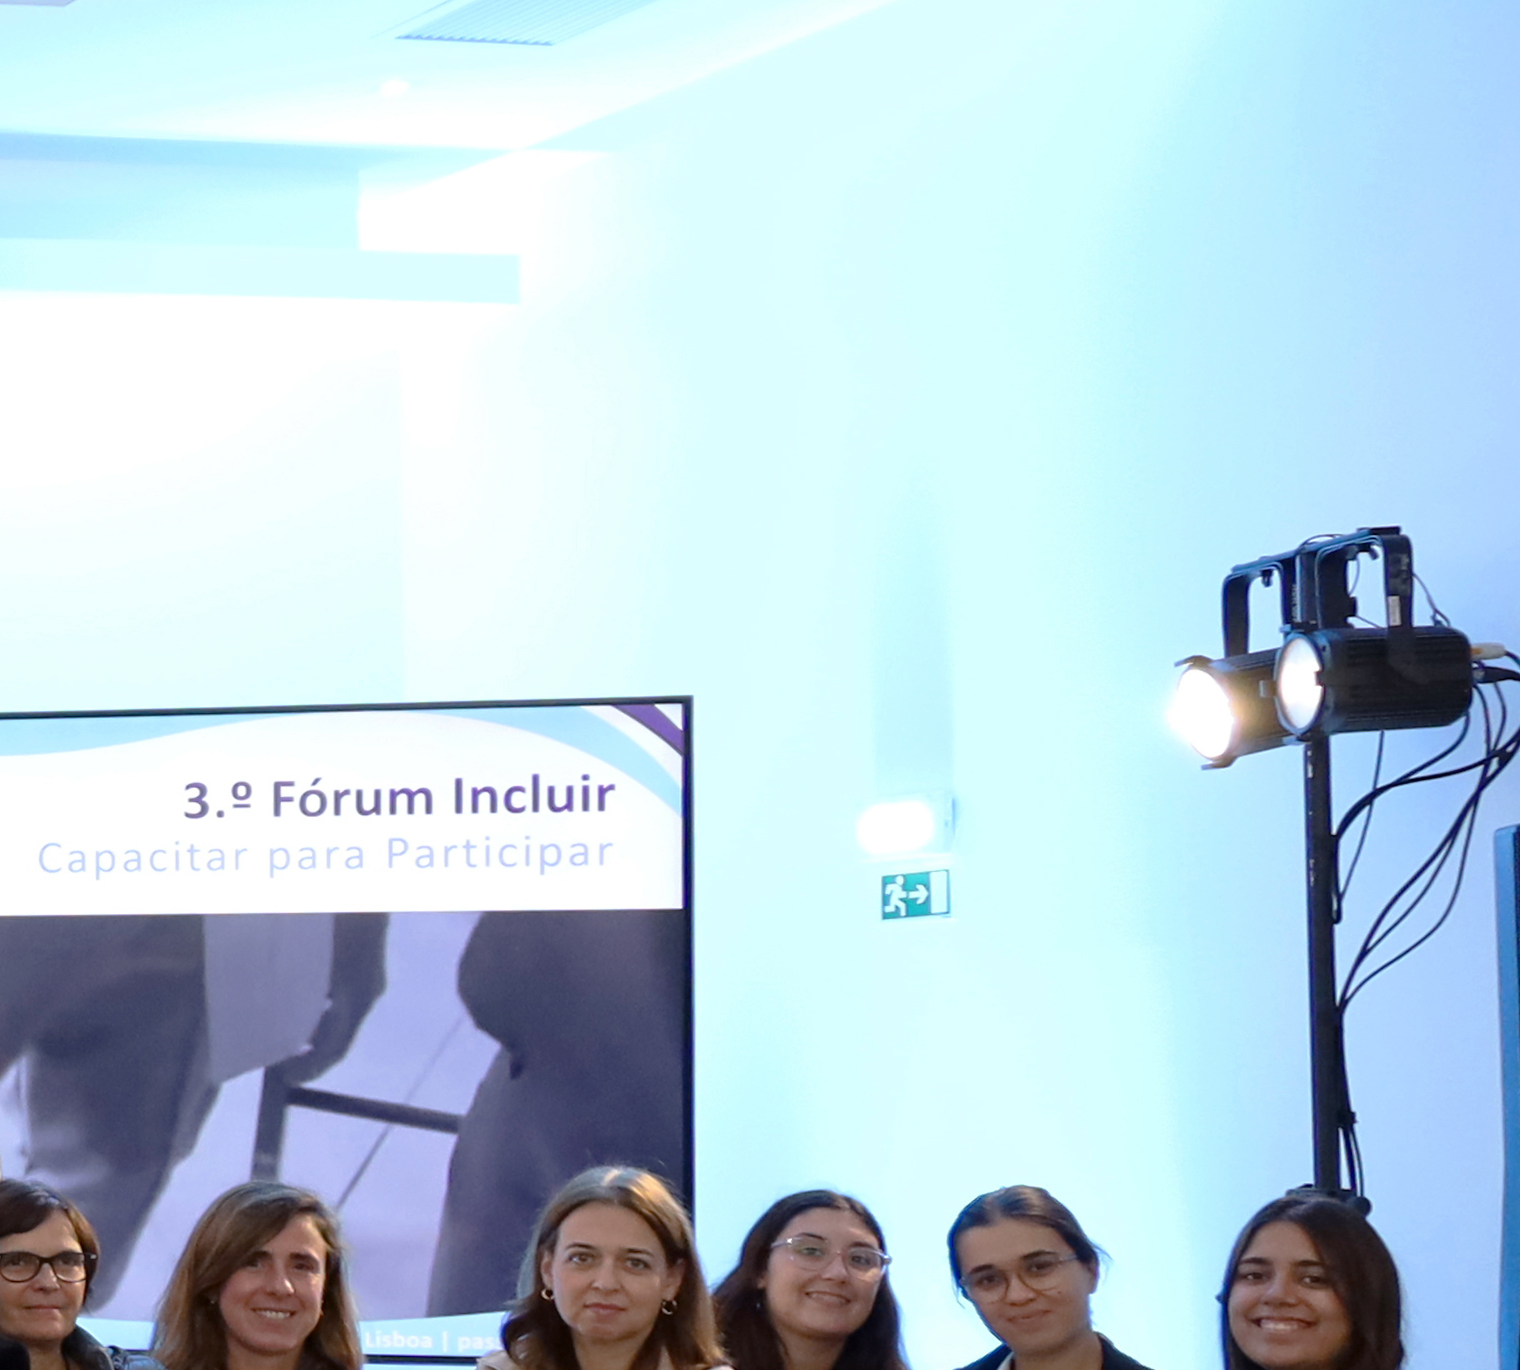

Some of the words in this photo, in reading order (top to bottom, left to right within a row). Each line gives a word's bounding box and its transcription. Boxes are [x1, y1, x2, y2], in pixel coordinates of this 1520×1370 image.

[272, 776, 435, 818] Fórum
[453, 773, 617, 814] Incluir
[37, 841, 248, 881] Capacitar
[268, 845, 365, 879] para
[387, 836, 614, 876] Participar
[364, 1331, 433, 1349] Lisboa
